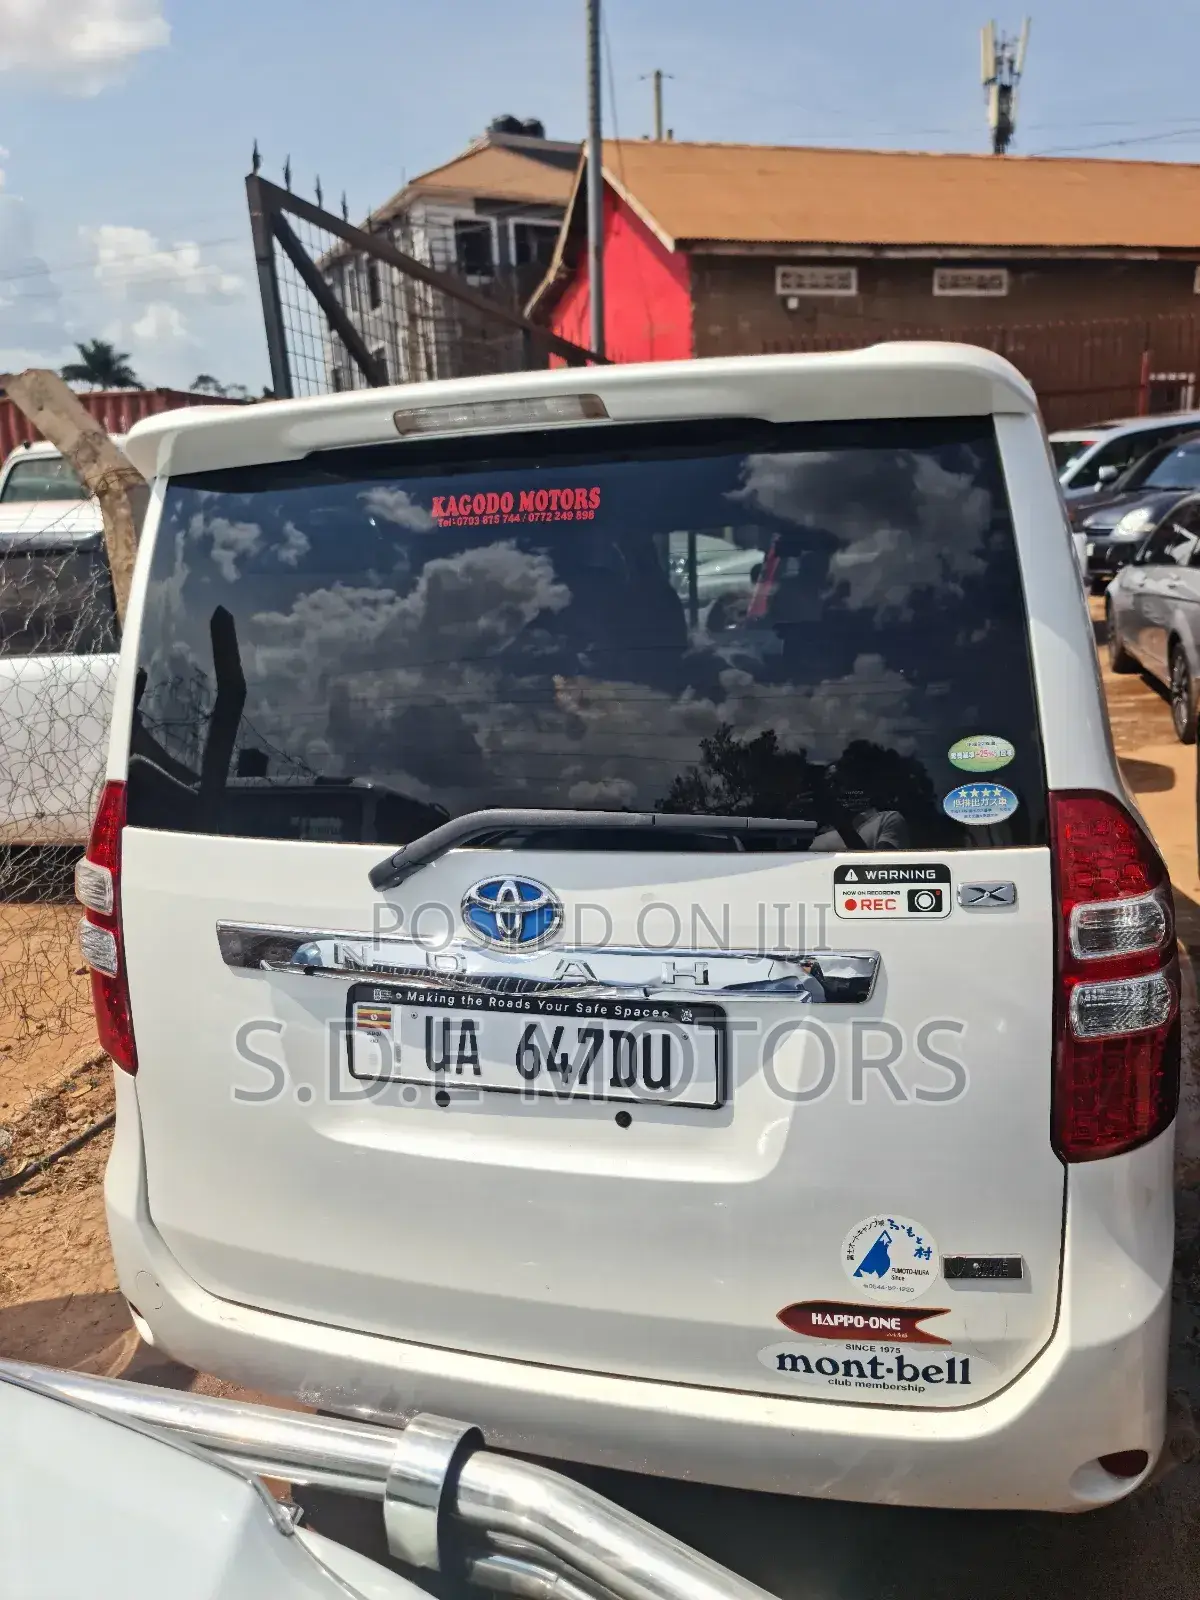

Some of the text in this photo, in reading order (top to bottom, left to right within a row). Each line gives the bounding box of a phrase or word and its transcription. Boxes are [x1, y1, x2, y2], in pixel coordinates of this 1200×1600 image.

[432, 487, 600, 517] KAGODO MOTORS
[865, 870, 936, 879] WARNING
[861, 899, 896, 911] REC
[407, 991, 662, 1018] Making the Roads Your Safe Space
[425, 1015, 671, 1090] UA 647DU
[887, 1218, 933, 1260] ふもと村
[811, 1312, 901, 1331] HAPPO-ONE
[845, 1343, 901, 1354] SINCE 1975
[828, 1377, 926, 1394] club membership
